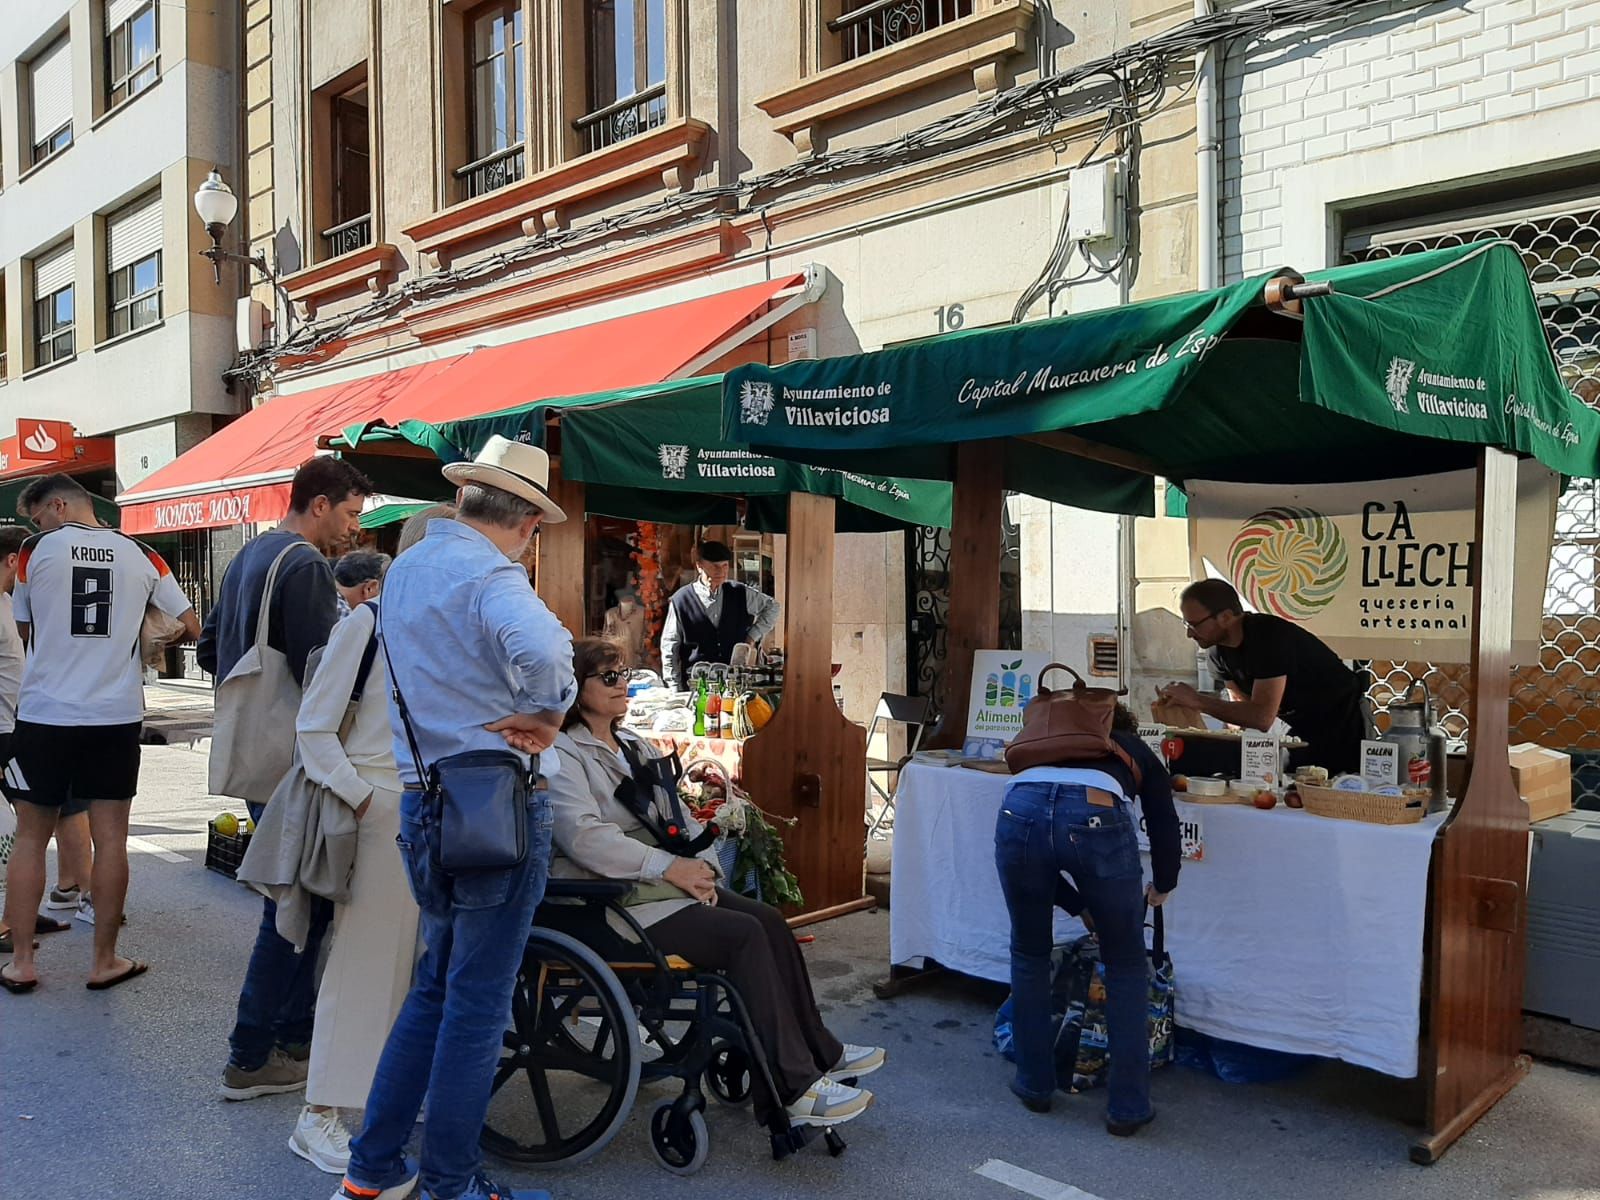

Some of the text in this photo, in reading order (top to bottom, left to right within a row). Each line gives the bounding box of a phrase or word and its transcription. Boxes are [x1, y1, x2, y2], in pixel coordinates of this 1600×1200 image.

[934, 306, 964, 332] 16
[958, 328, 1228, 408] Capital Manzanera de Esp
[1417, 367, 1486, 391] Ayuntamiento de
[783, 381, 891, 402] Ayuntamiento de
[784, 406, 890, 426] Villaviciosa
[1416, 391, 1488, 419] Villaviciosa
[141, 455, 149, 469] 18
[697, 463, 776, 477] Villaviciosa
[208, 494, 251, 522] MODA
[1361, 500, 1416, 541] CA
[71, 545, 115, 563] KROOS
[71, 566, 113, 638] 8
[1359, 593, 1455, 614] quesería
[1360, 614, 1468, 629] artesanal
